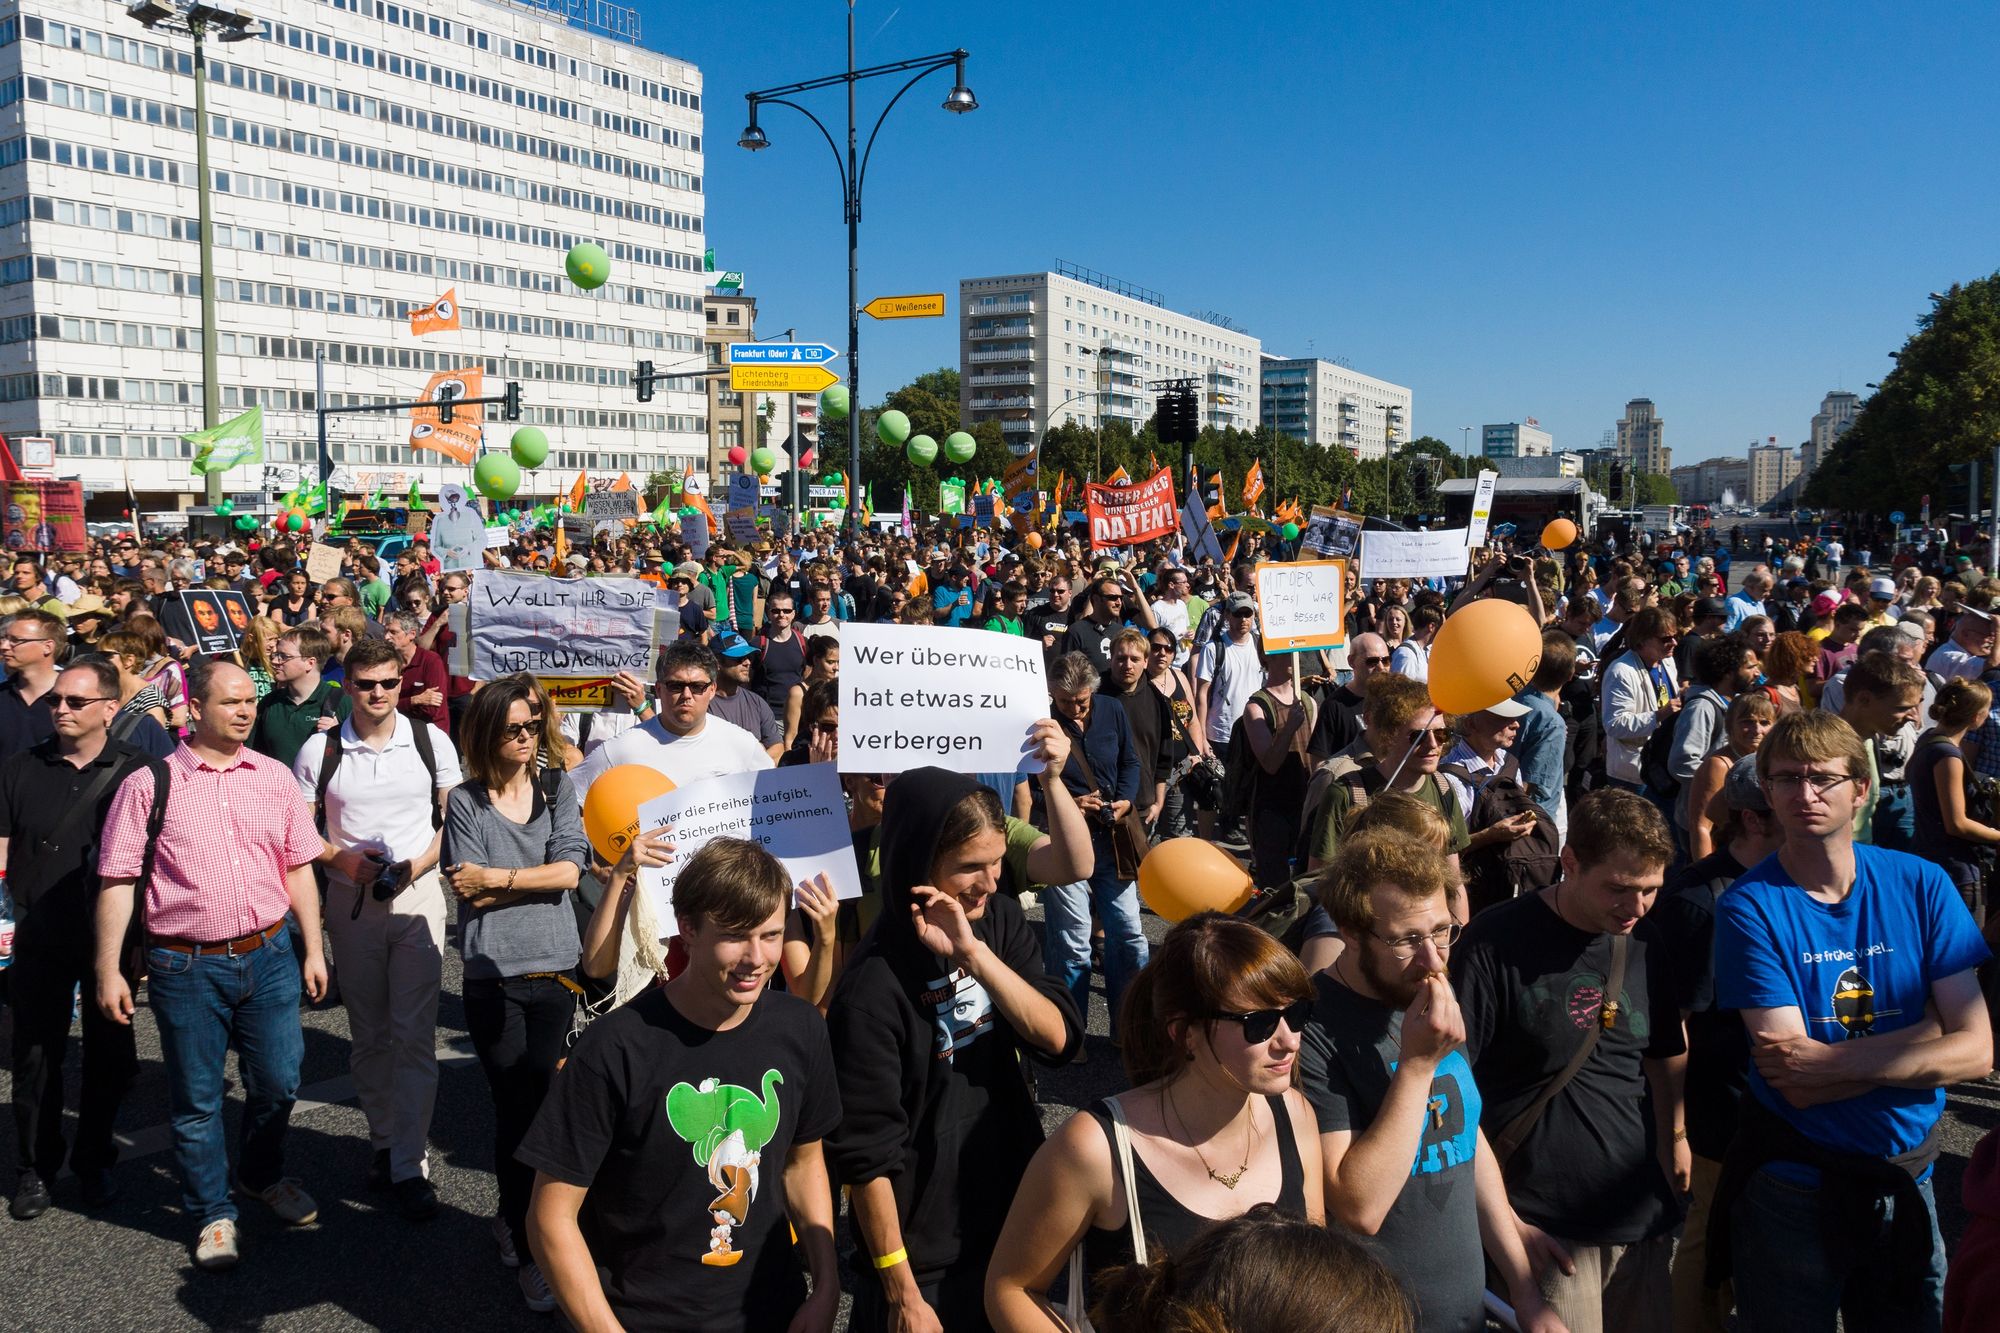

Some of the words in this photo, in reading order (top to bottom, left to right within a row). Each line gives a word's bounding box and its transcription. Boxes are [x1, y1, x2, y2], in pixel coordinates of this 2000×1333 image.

[723, 272, 741, 281] AOK
[895, 301, 937, 313] Weißensee
[734, 349, 766, 358] Frankfurt
[768, 349, 788, 358] (Oder)
[736, 370, 789, 380] Lichtenberg
[742, 379, 789, 388] Friedrichshain
[437, 427, 478, 444] PIRATEN
[615, 492, 628, 500] WIR
[1091, 489, 1142, 506] FINGER
[1143, 475, 1169, 499] WEG
[588, 500, 610, 509] WISSEN
[1104, 505, 1123, 515] VON
[1124, 496, 1159, 515] UNSEREN
[1093, 502, 1174, 541] DATEN!
[1264, 571, 1287, 594] MIT
[1289, 570, 1315, 588] DER
[484, 585, 570, 608] WOLLT
[581, 589, 608, 607] IHR
[1266, 594, 1299, 611] STASI
[1313, 592, 1334, 605] WAR
[1294, 611, 1326, 623] BESSER
[491, 644, 651, 674] ÜBERWACHUNG?
[853, 645, 904, 665] Wer
[911, 648, 1038, 675] überwacht
[549, 686, 582, 700] rkel
[588, 685, 608, 699] 21
[854, 687, 894, 707] hat
[900, 689, 974, 708] etwas
[980, 694, 1007, 709] zu
[852, 730, 983, 755] verbergen
[684, 805, 706, 819] die
[708, 794, 760, 813] Freiheit
[762, 787, 813, 804] aufgibt,
[679, 818, 747, 841] Sicherheit
[749, 817, 763, 827] zu
[766, 806, 833, 825] gewinnen,
[1803, 952, 1823, 964] Der
[1823, 949, 1855, 962] frühe
